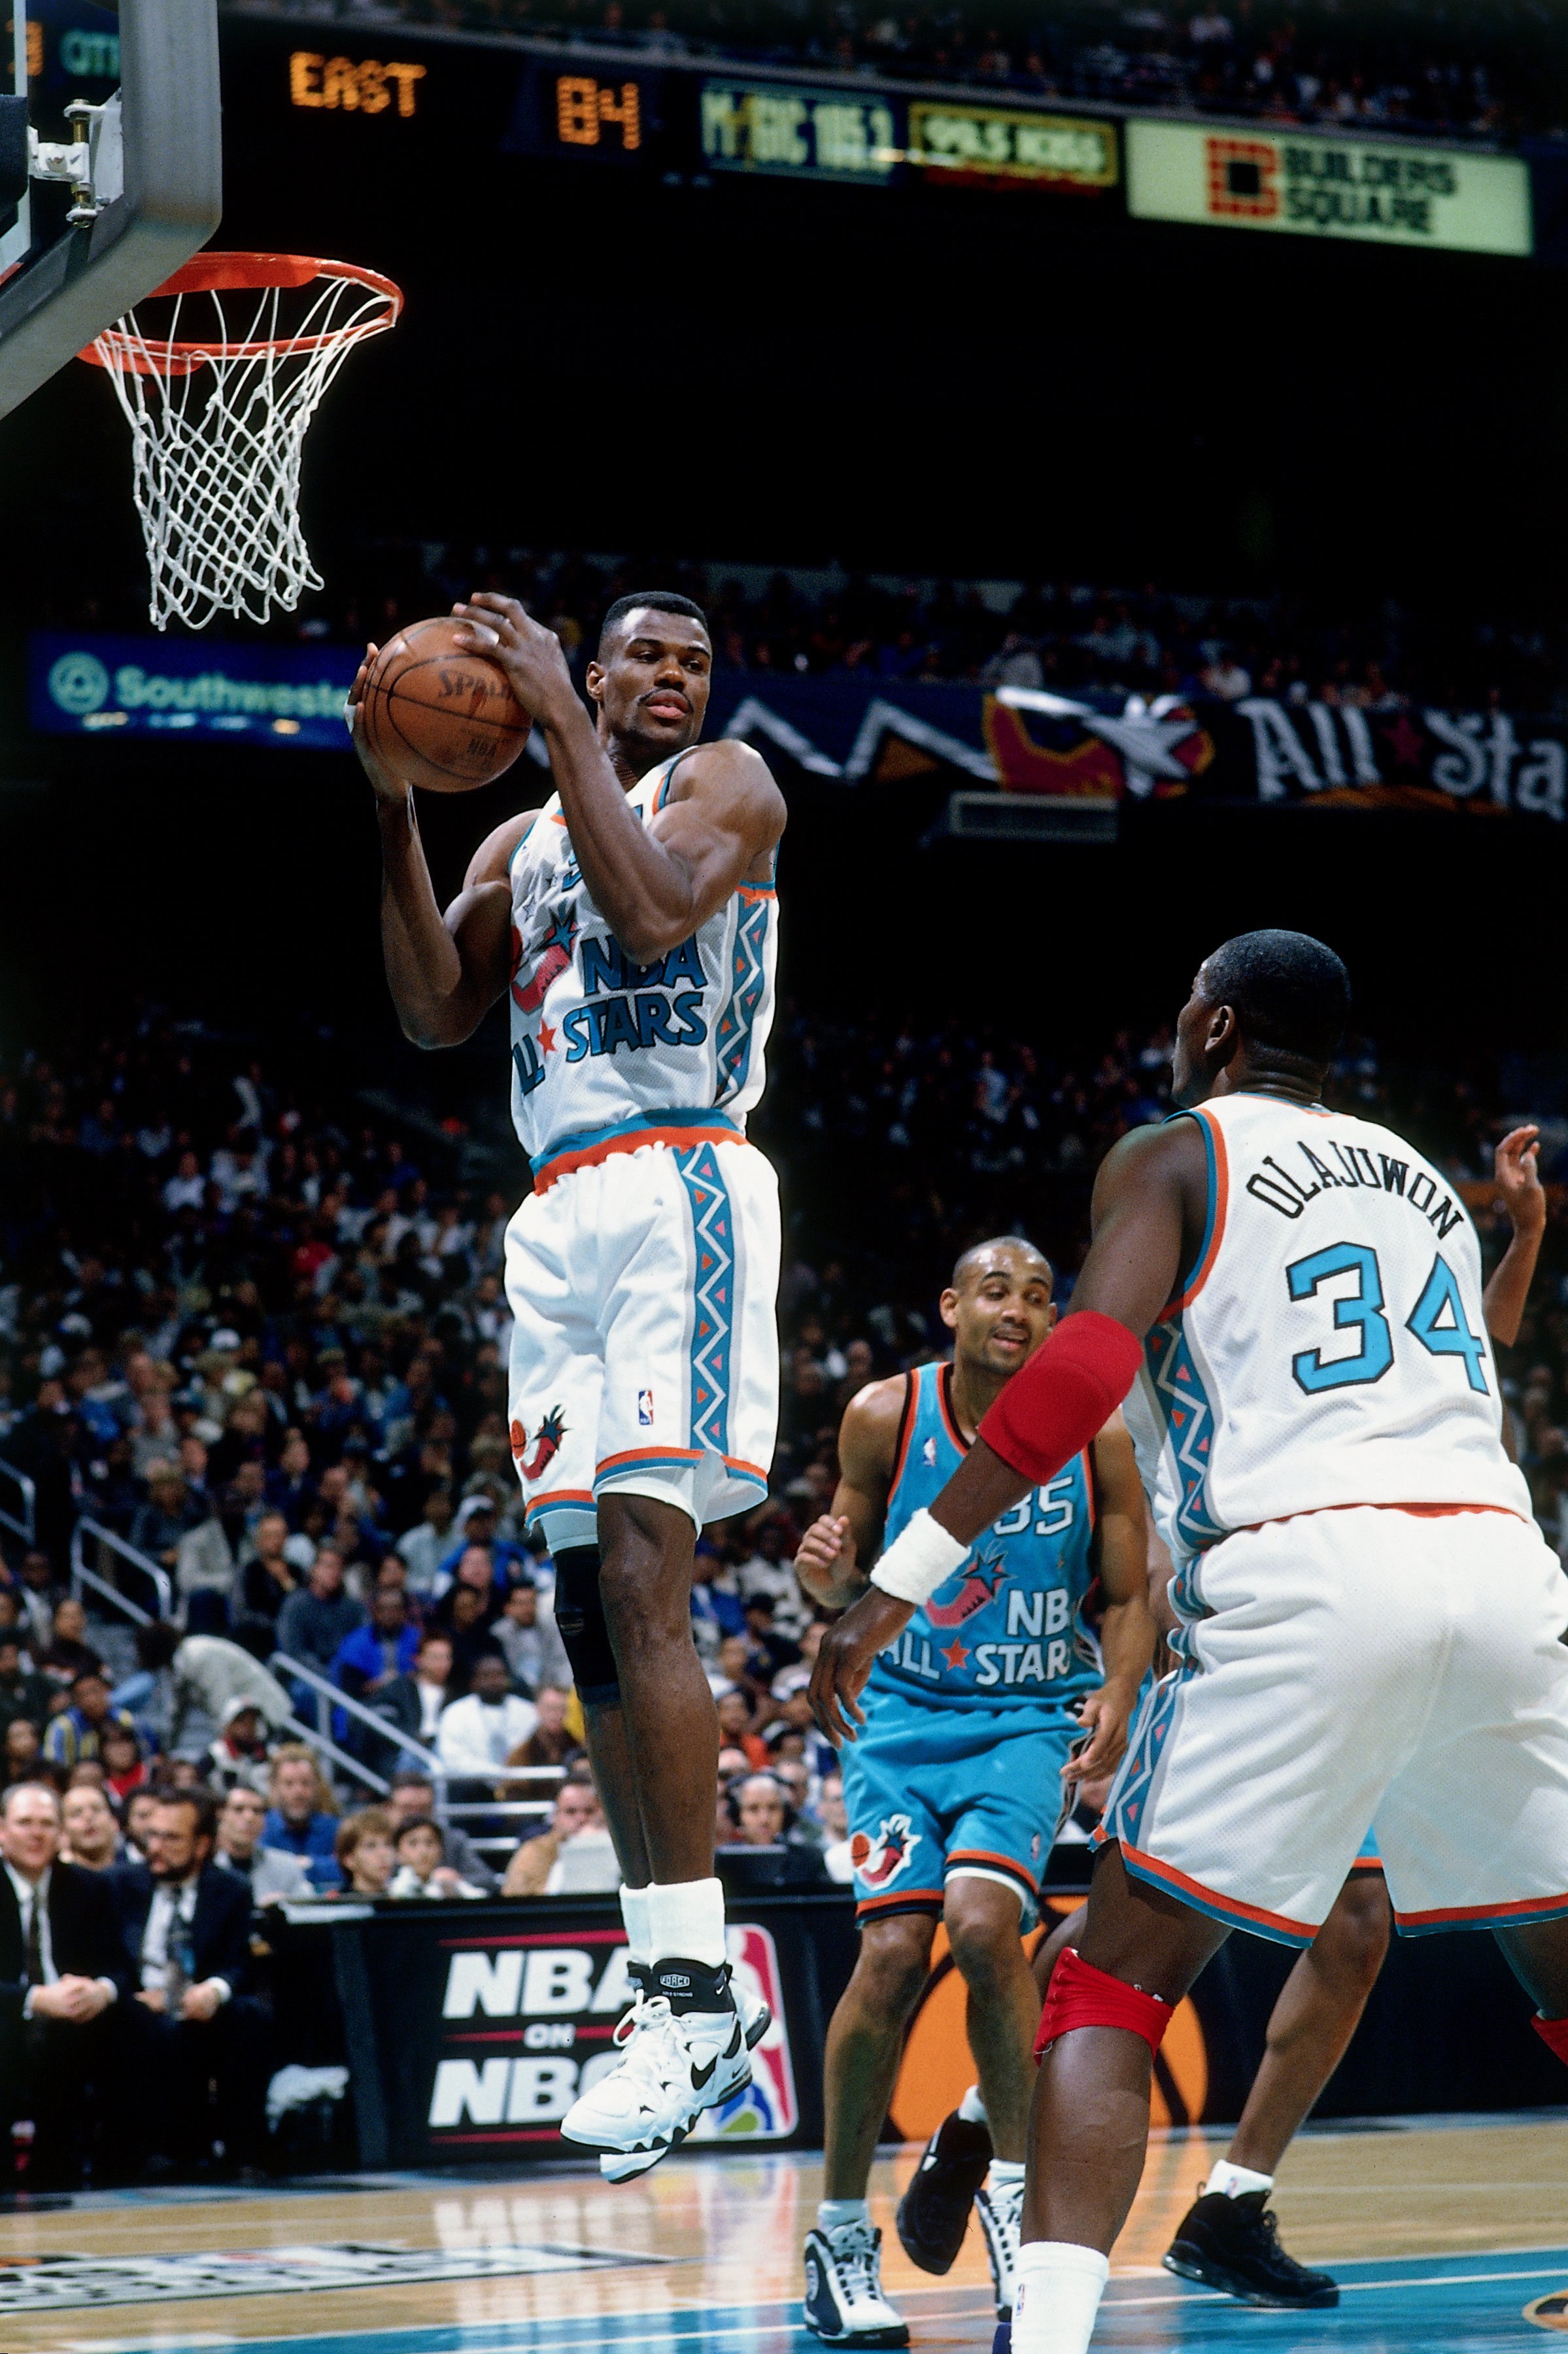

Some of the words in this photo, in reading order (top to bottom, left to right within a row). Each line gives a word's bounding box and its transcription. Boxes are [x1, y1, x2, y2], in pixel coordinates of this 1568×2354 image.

[290, 51, 426, 118] EAST
[556, 75, 641, 150] 84
[1284, 146, 1458, 196] BUILDERS
[1284, 186, 1434, 235] SQUARE
[1235, 697, 1383, 802] All
[1423, 706, 1568, 821] Sta
[512, 1034, 546, 1096] LL
[562, 991, 708, 1063] STARS
[1246, 1140, 1464, 1240] OLAJUWON
[1286, 1241, 1491, 1396] 34
[878, 1630, 941, 1680] ALL
[525, 2022, 577, 2049] ON
